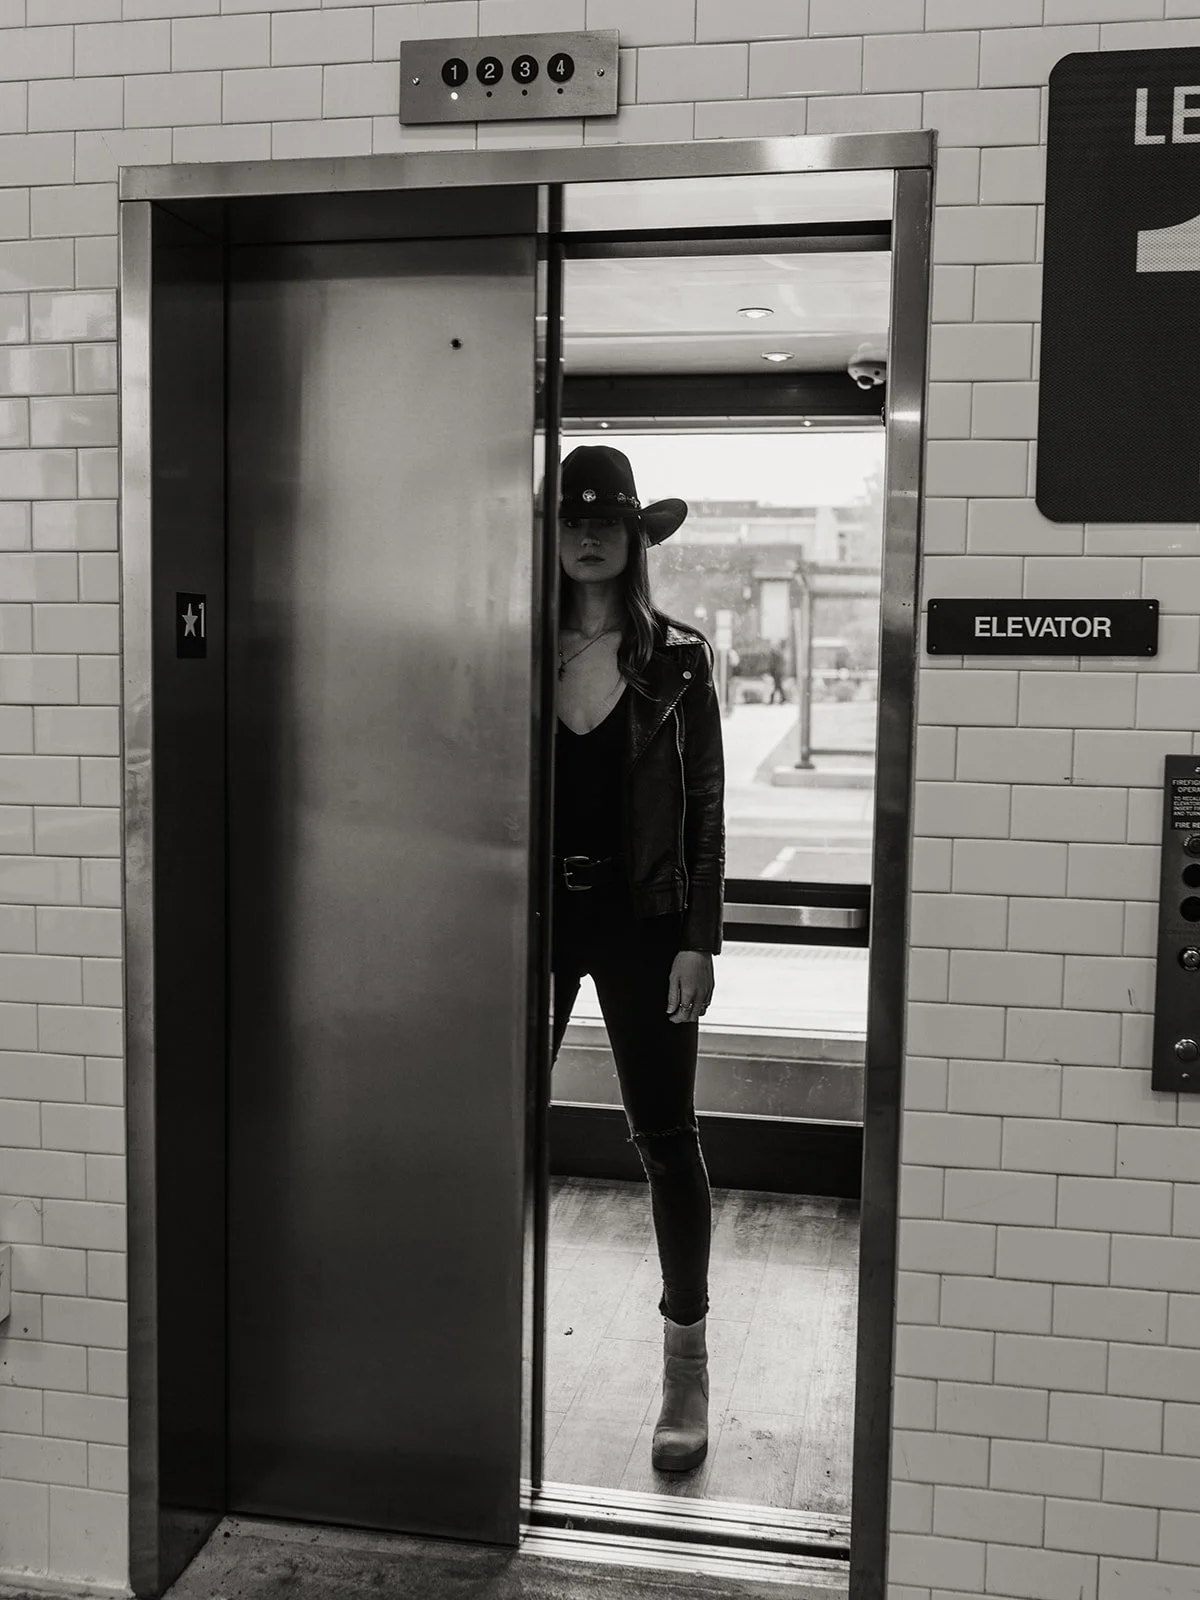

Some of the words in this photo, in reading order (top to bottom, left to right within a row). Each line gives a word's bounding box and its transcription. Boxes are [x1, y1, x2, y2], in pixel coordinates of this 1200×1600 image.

[450, 65, 457, 80] 1
[484, 63, 495, 79] 2
[519, 61, 530, 77] 3
[556, 60, 565, 75] 4
[974, 616, 1112, 638] ELEVATOR
